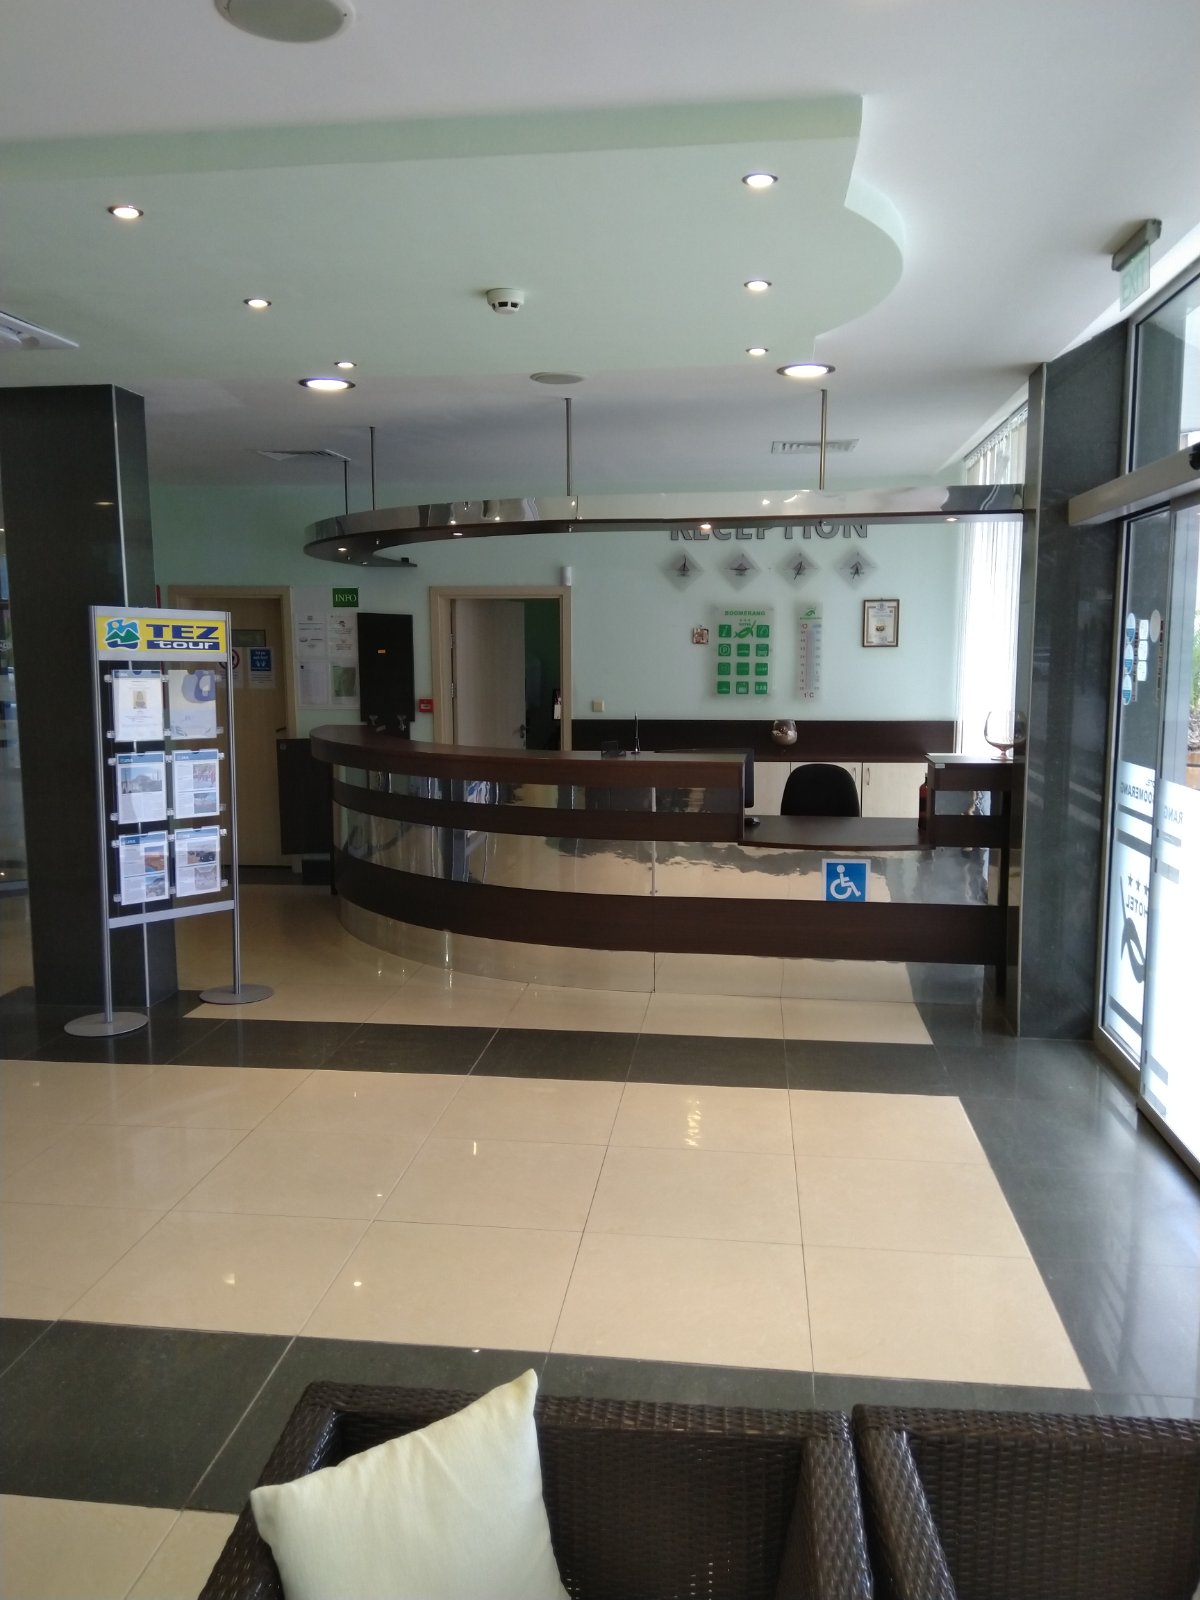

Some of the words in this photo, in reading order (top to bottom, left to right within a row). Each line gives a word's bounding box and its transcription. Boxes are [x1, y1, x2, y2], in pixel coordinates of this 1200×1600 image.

[335, 594, 357, 602] INFO
[146, 624, 220, 640] TEZ
[153, 641, 214, 649] tour
